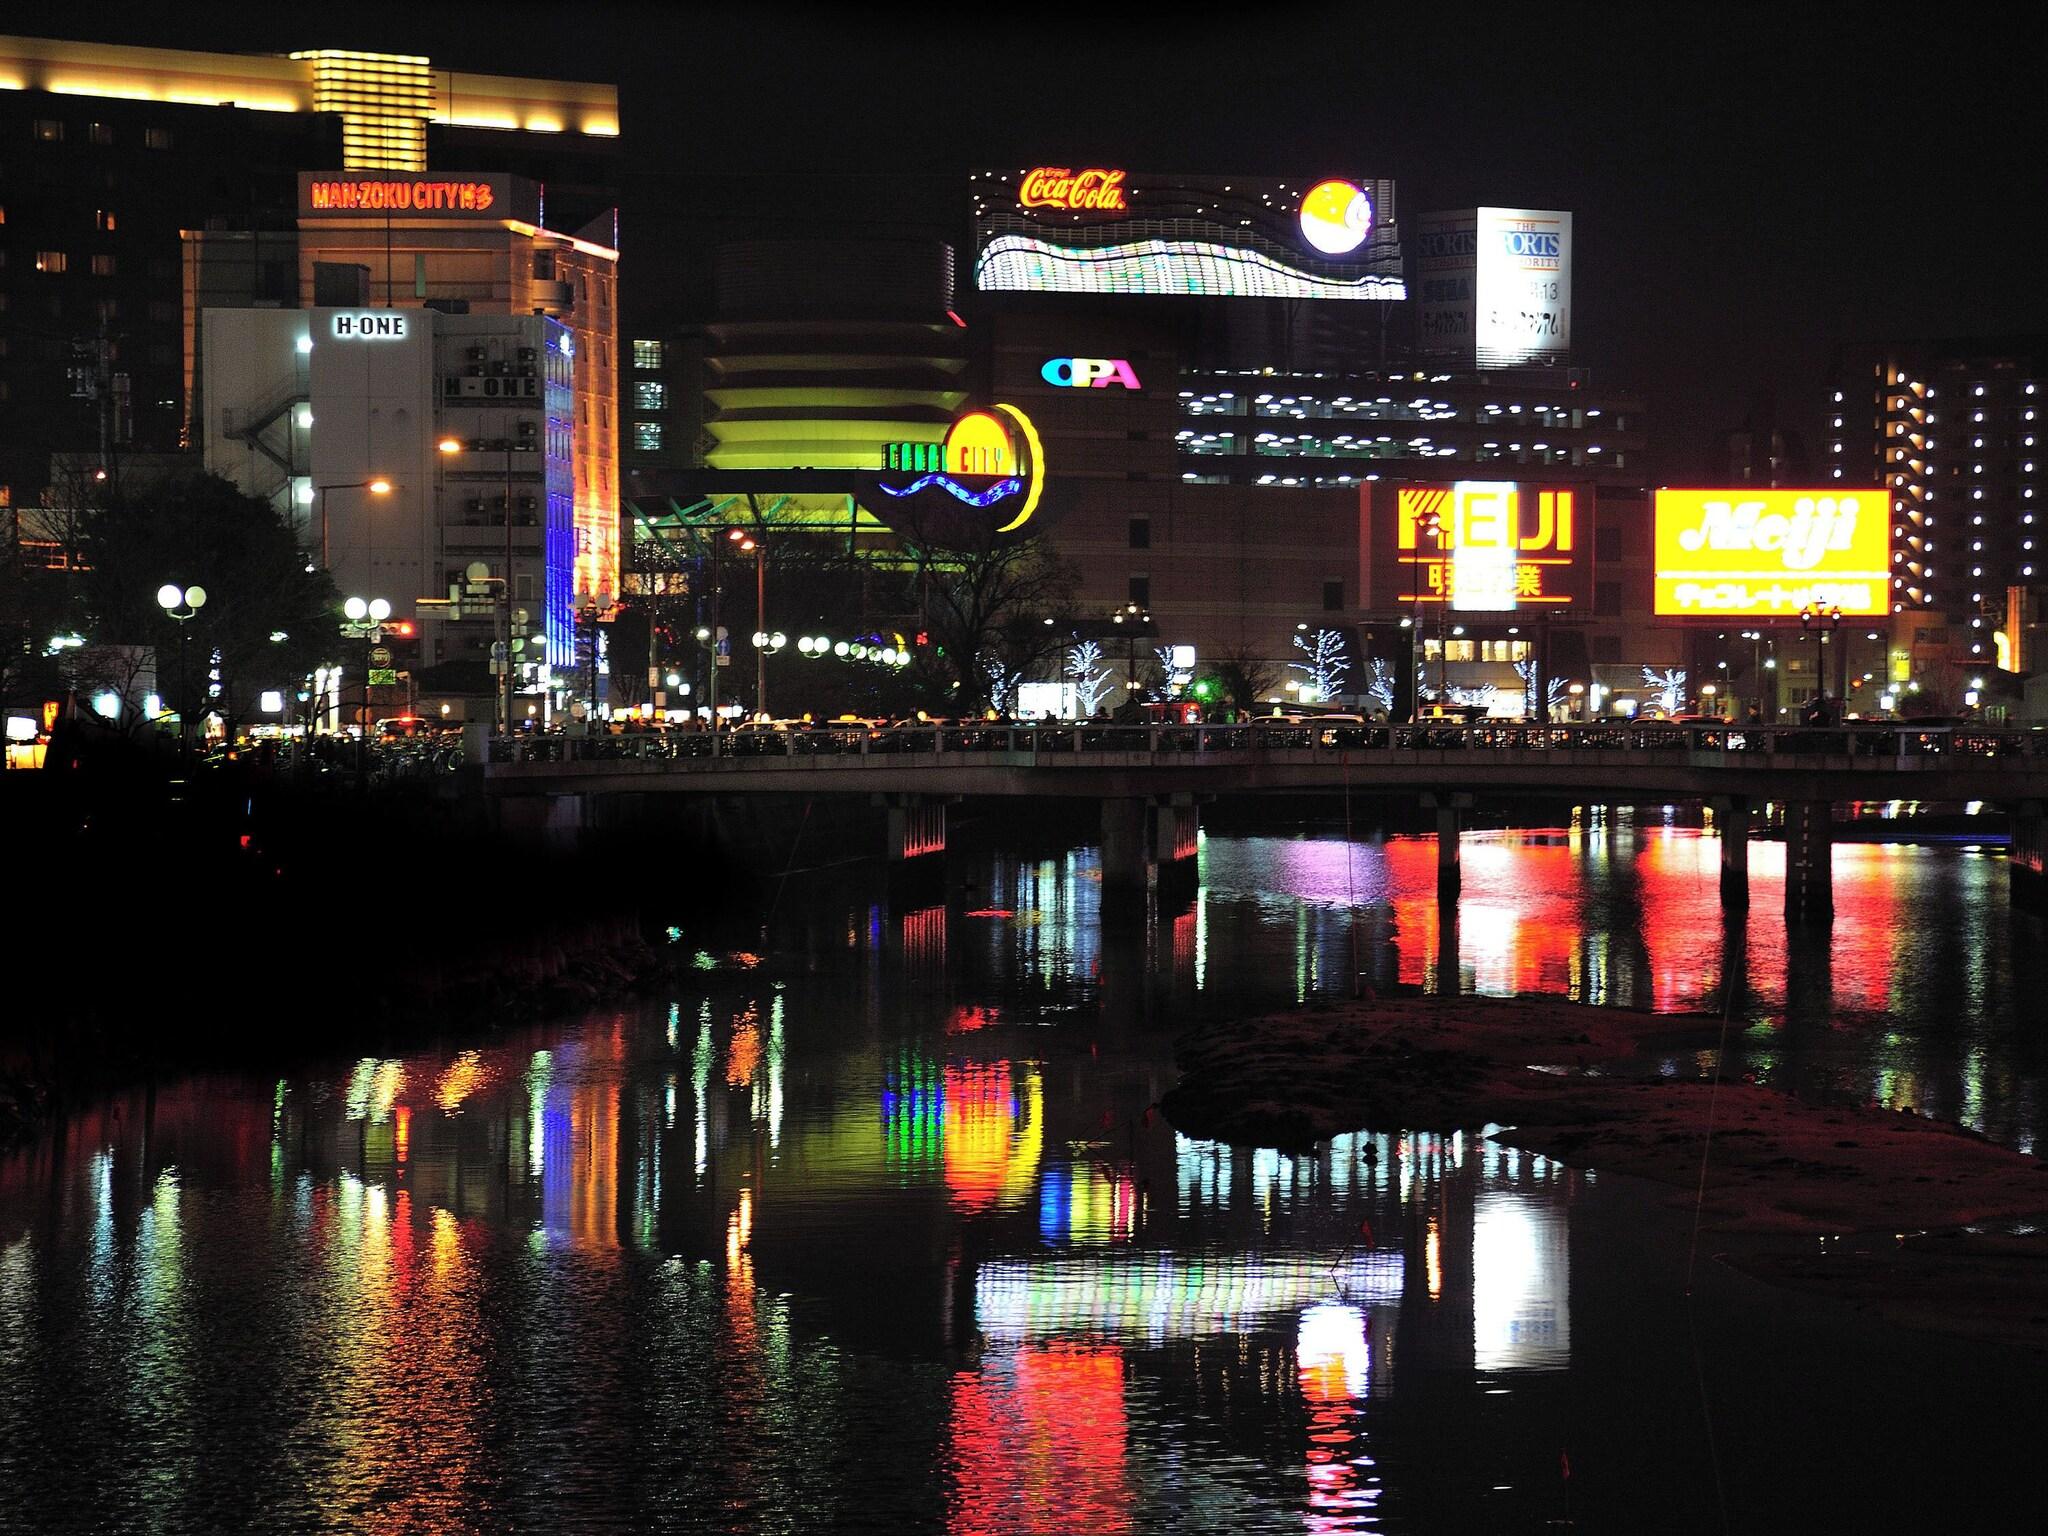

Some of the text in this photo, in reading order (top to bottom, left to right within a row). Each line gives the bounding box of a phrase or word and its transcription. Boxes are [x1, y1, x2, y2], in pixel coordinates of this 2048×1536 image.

[412, 182, 459, 210] CITY
[1516, 222, 1536, 232] THE
[337, 317, 403, 336] H-ONE
[1041, 358, 1142, 389] OPA
[961, 446, 1003, 473] CITY
[1398, 489, 1574, 551] MEIJI
[1678, 497, 1859, 571] Meiji
